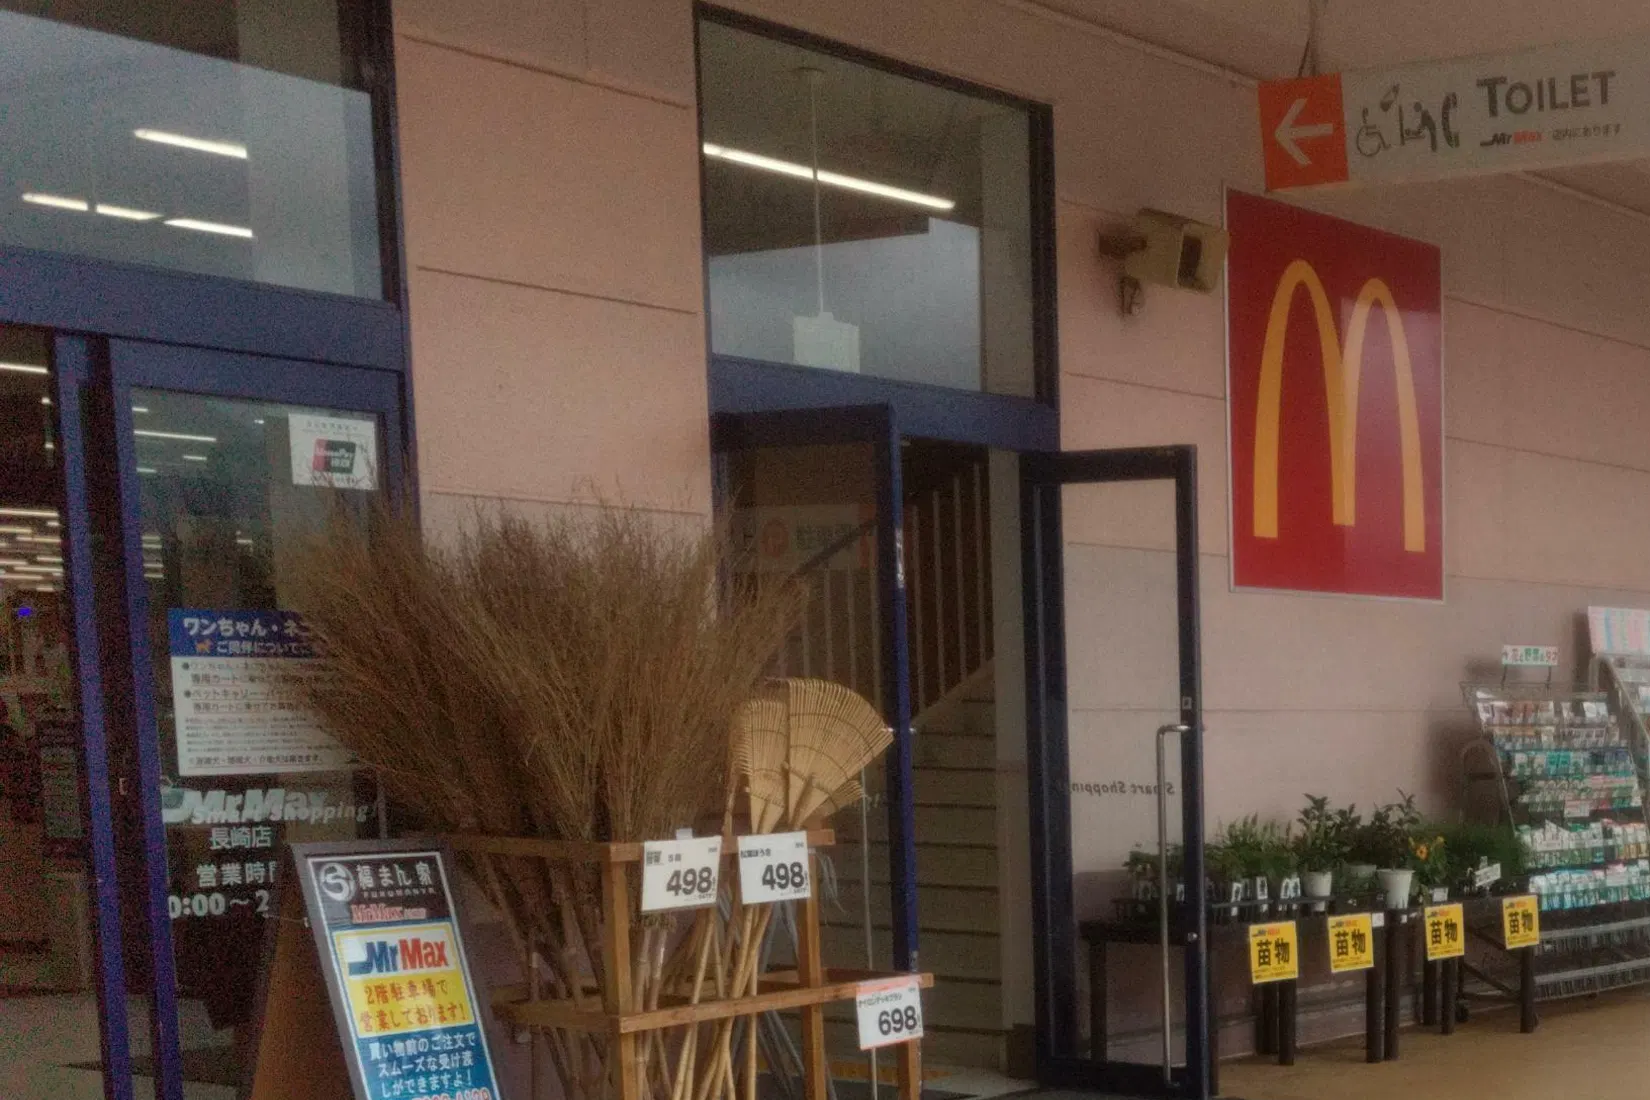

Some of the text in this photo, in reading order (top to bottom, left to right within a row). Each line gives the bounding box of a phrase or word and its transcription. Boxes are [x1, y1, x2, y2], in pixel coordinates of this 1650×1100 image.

[1476, 70, 1617, 118] TOILET
[209, 826, 272, 850] 長崎店
[666, 866, 713, 897] 498
[762, 861, 805, 891] 498
[349, 937, 449, 976] MrMax
[1256, 937, 1290, 967] 苗物
[1334, 928, 1366, 957] 苗物
[878, 1005, 917, 1036] 698
